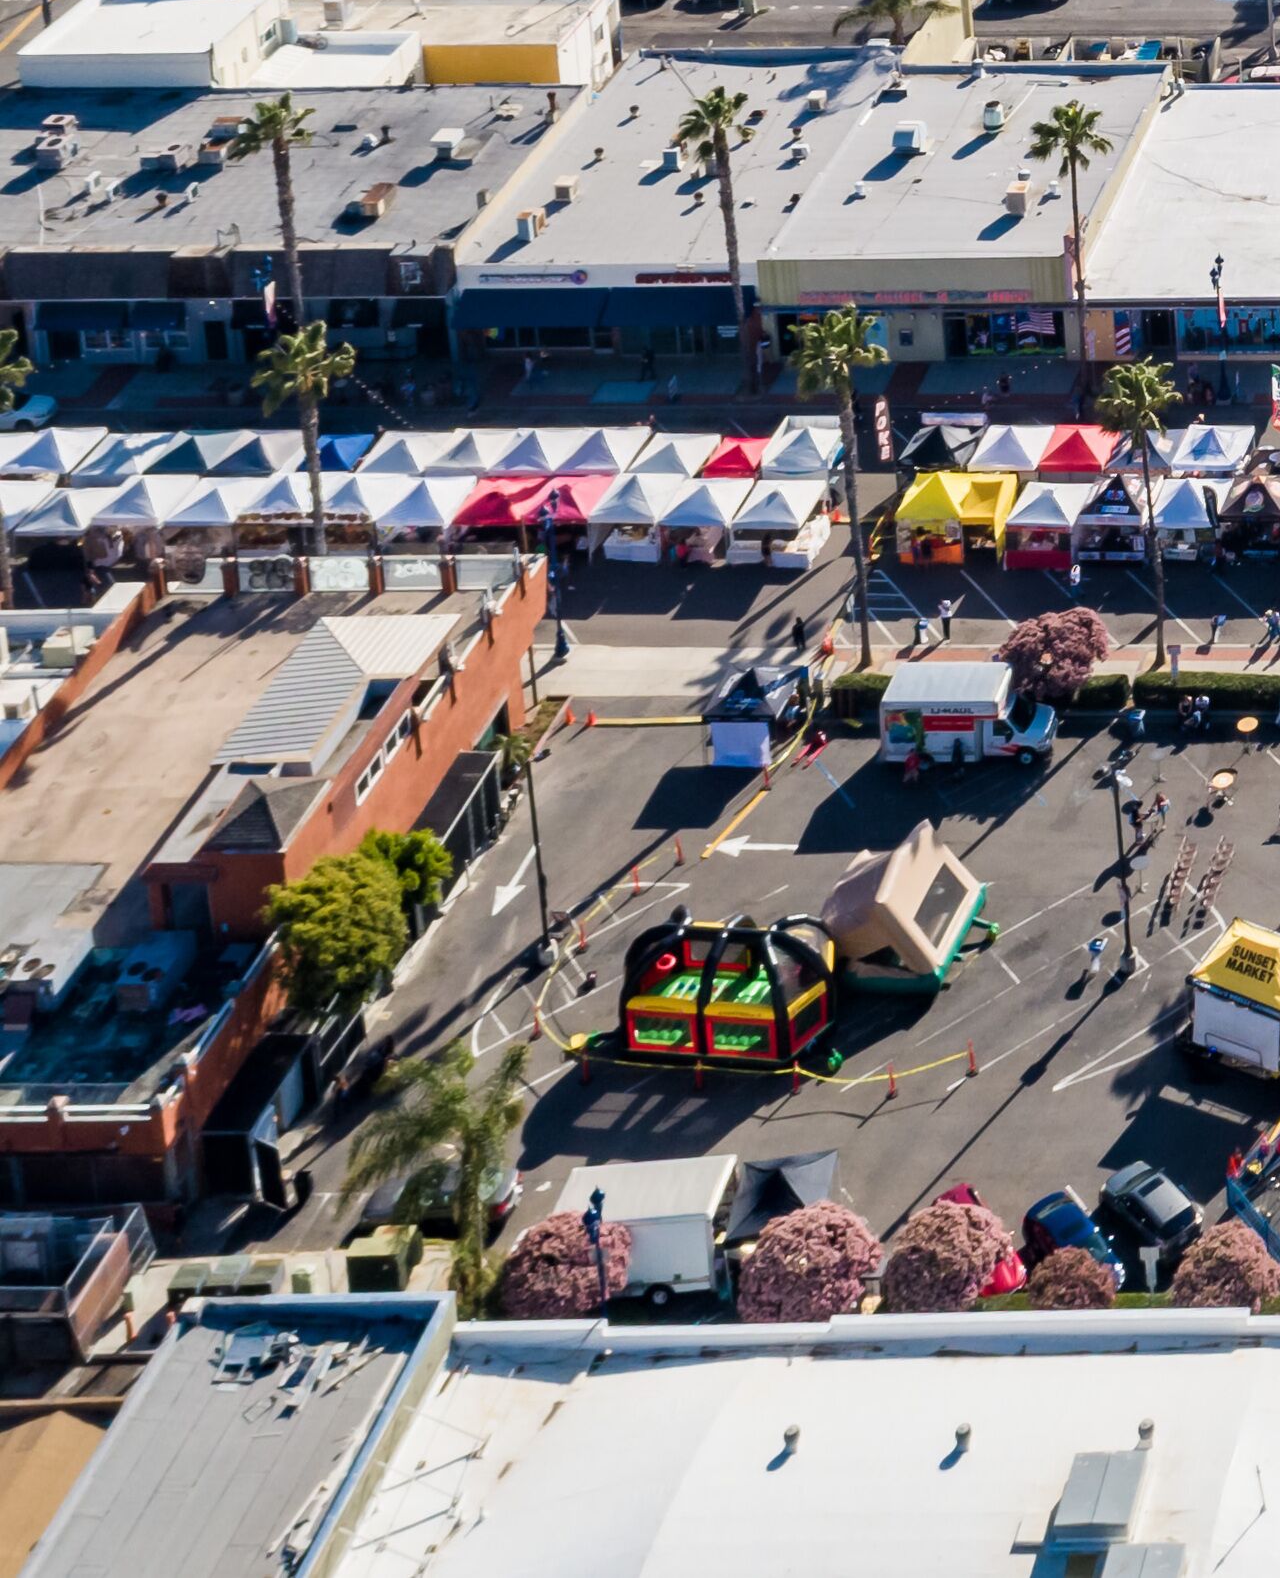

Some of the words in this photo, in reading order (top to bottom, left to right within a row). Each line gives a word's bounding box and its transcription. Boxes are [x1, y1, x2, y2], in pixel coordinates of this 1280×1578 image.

[875, 401, 890, 460] POKE
[1225, 957, 1275, 984] MARKET
[1232, 945, 1277, 971] SUNSET
